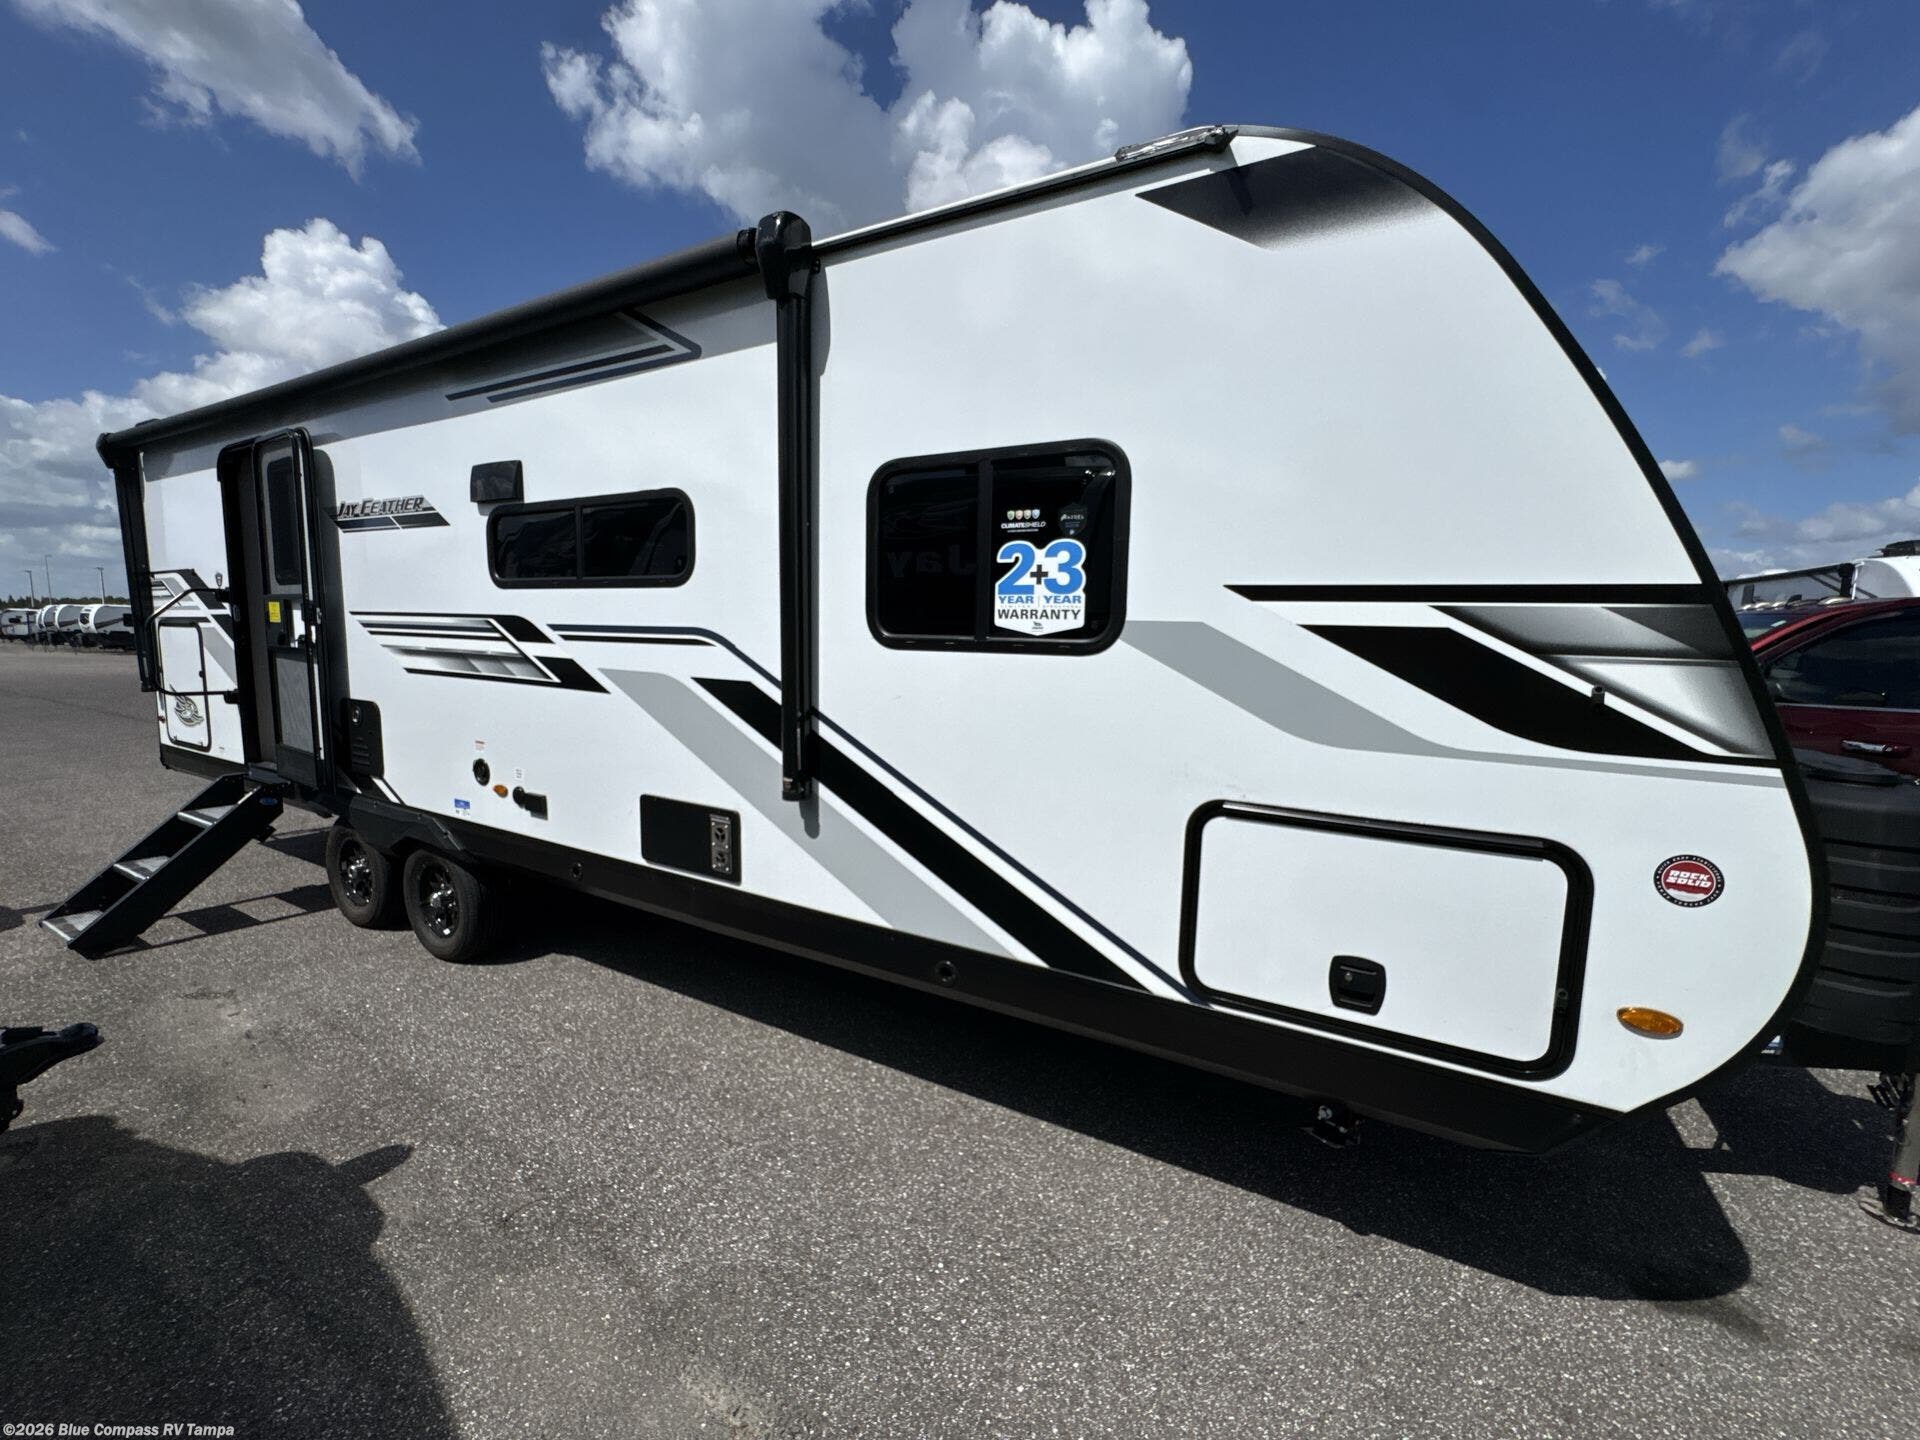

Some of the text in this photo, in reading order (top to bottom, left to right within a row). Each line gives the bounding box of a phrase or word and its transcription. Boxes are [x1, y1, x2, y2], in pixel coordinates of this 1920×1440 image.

[361, 497, 424, 515] FEATHER
[998, 595, 1082, 604] YEAR YEAR
[998, 609, 1081, 620] WARRANTY
[1669, 870, 1710, 881] ROCK
[1666, 876, 1712, 888] SOLID
